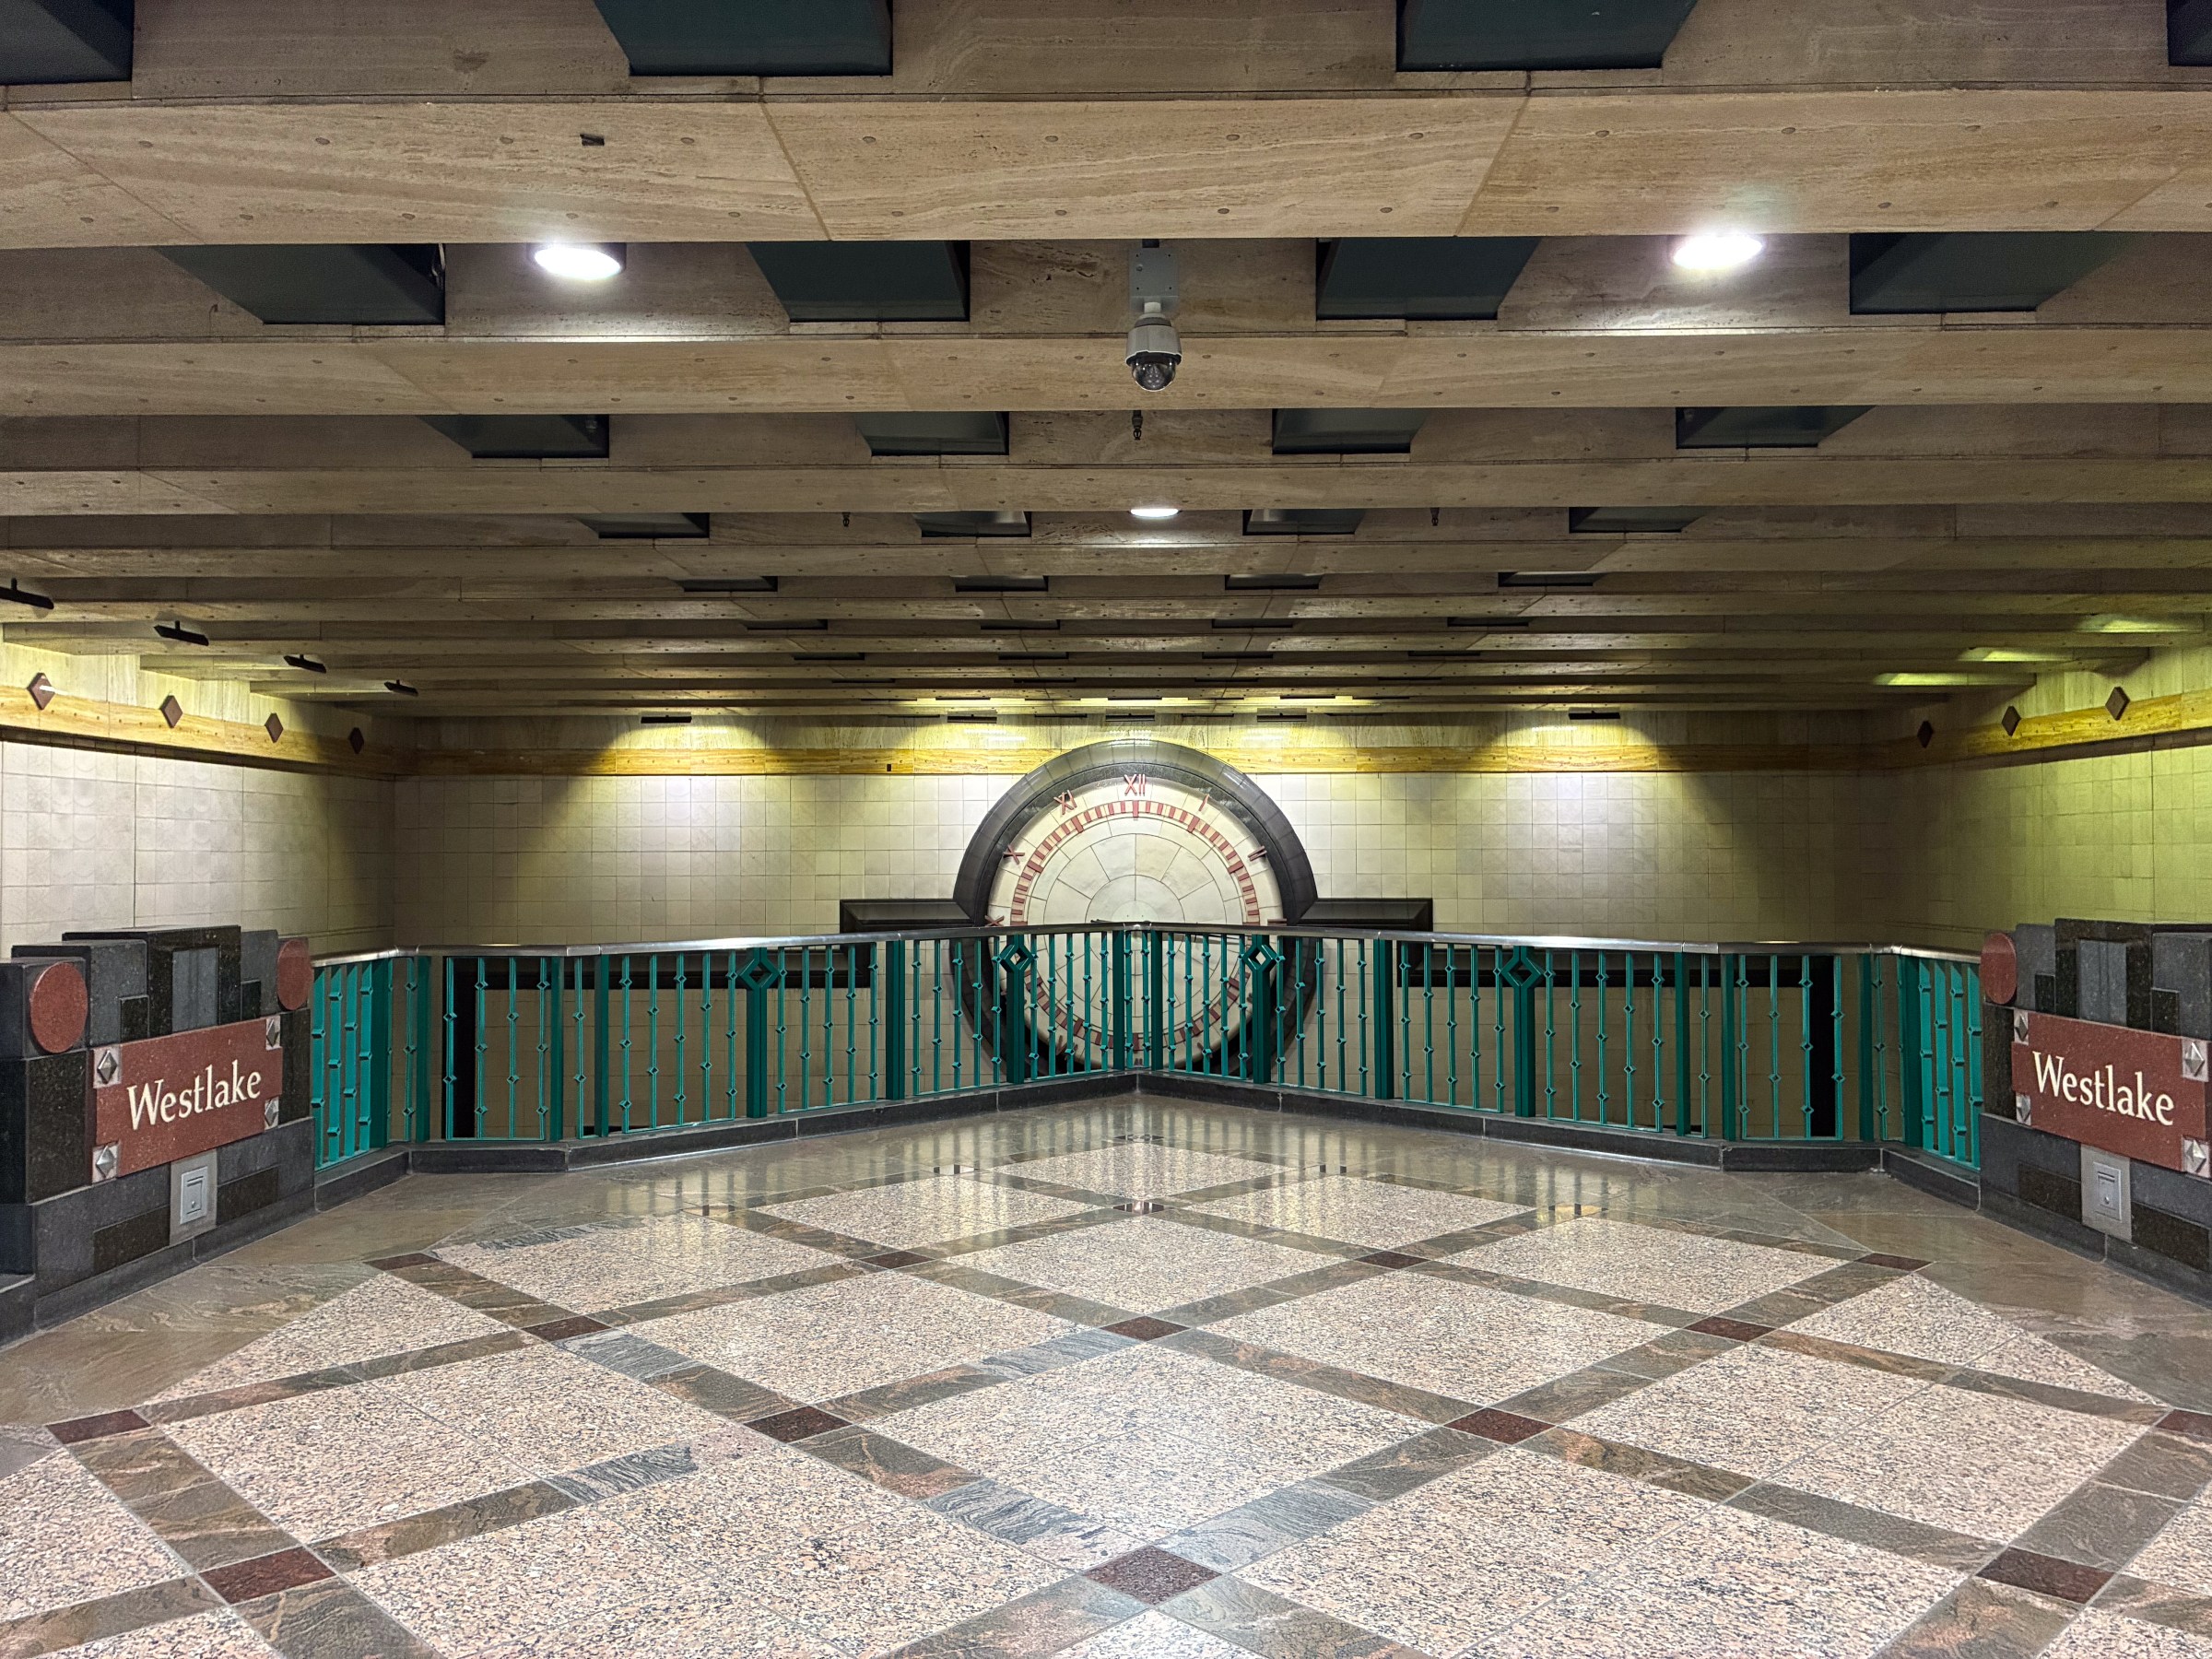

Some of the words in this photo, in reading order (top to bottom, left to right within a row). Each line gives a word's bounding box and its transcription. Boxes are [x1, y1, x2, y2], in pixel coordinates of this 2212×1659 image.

[1124, 774, 1146, 796] XII
[1053, 790, 1077, 816] XI
[1003, 845, 1025, 865] X
[126, 1059, 262, 1131] Westlake
[2032, 1051, 2174, 1126] Westlake
